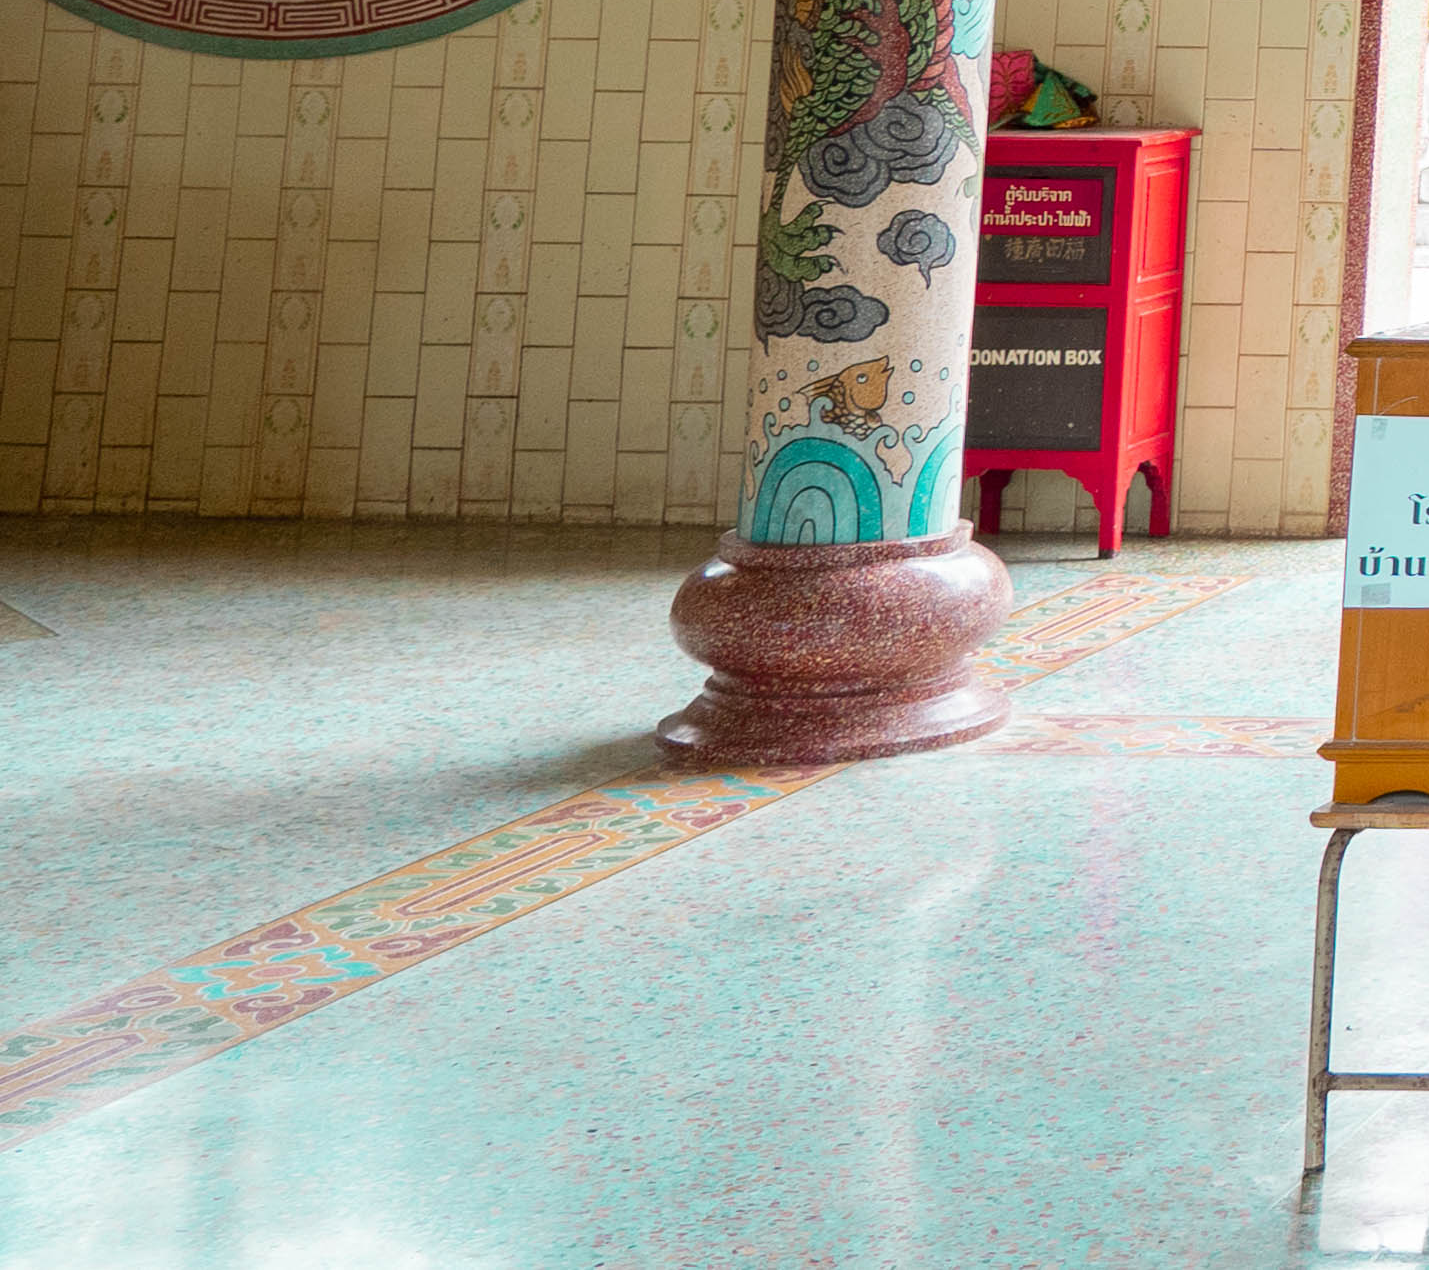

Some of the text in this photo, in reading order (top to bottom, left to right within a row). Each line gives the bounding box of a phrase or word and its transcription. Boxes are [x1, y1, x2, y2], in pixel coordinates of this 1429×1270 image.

[1005, 184, 1072, 205] ตู้รับบริจาค
[970, 348, 1102, 365] DONATION BOX
